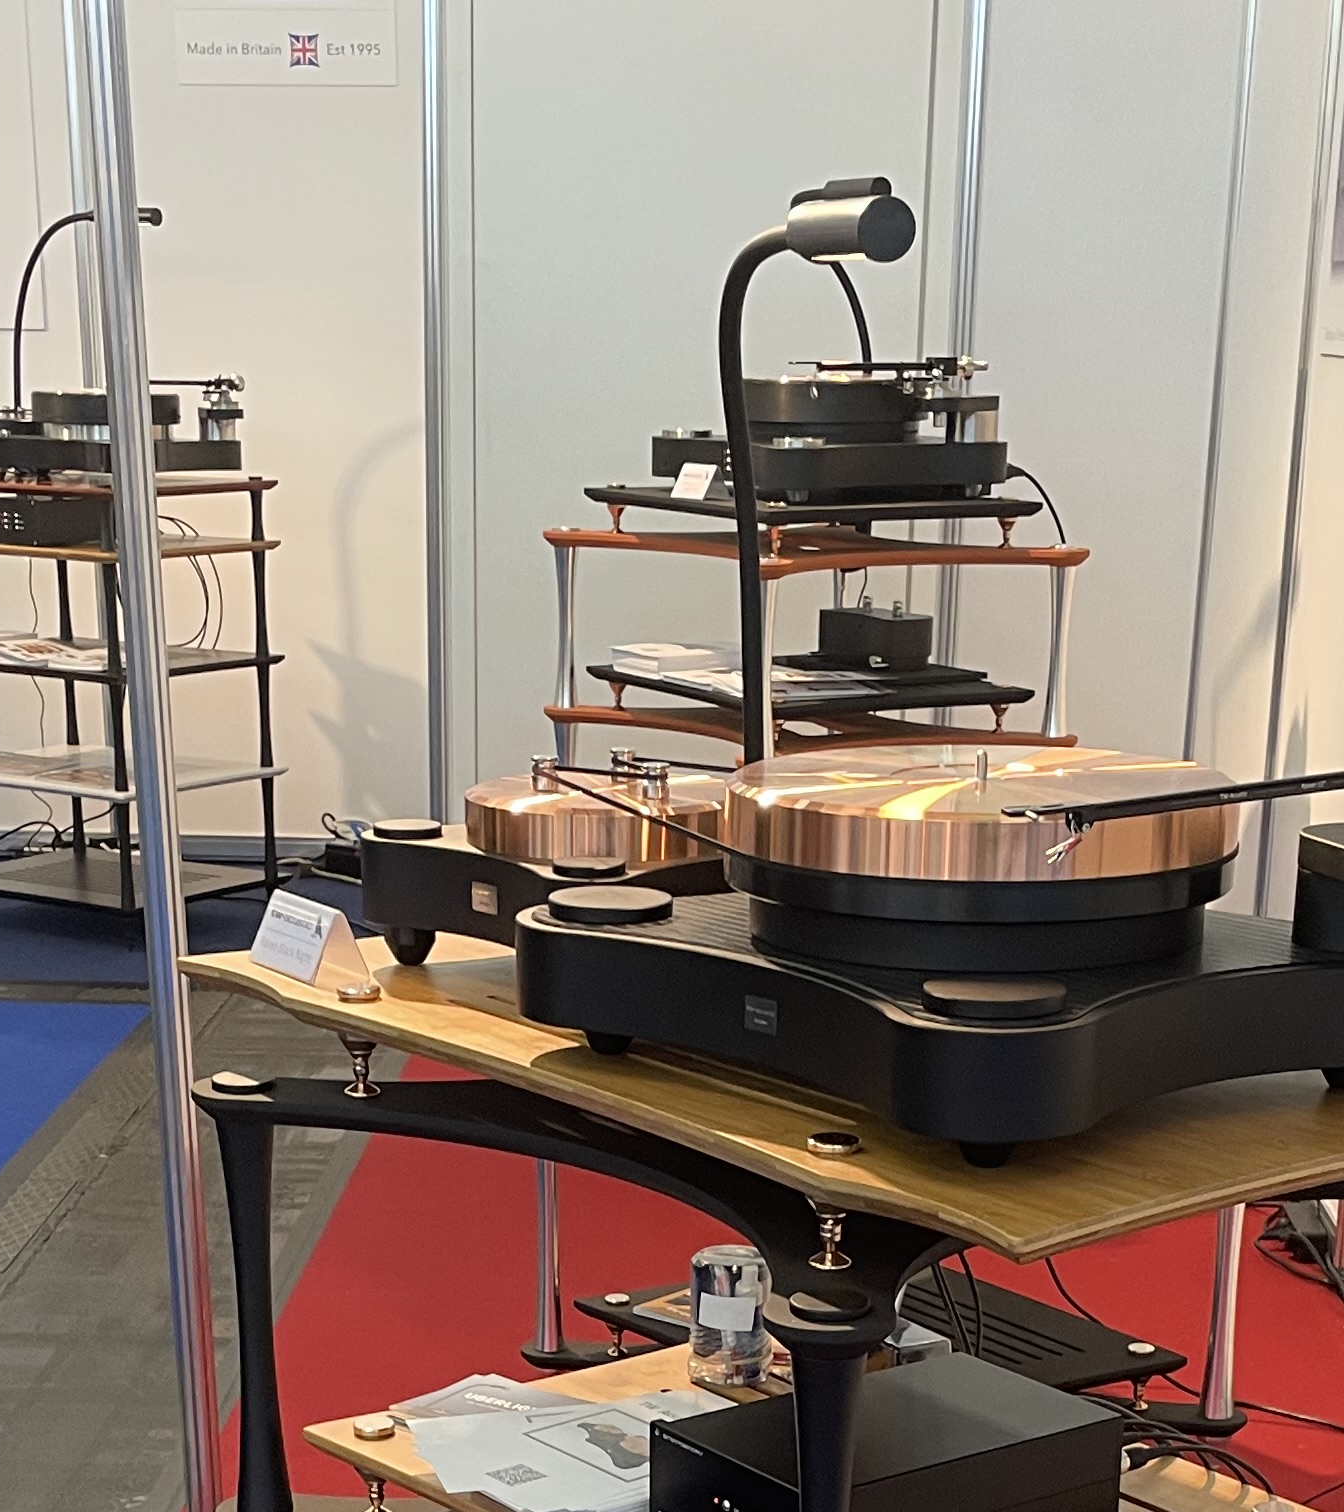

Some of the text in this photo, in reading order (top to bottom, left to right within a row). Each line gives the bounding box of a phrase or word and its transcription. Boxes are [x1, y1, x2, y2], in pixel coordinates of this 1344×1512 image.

[186, 42, 381, 56] Made in Britain Est 1995
